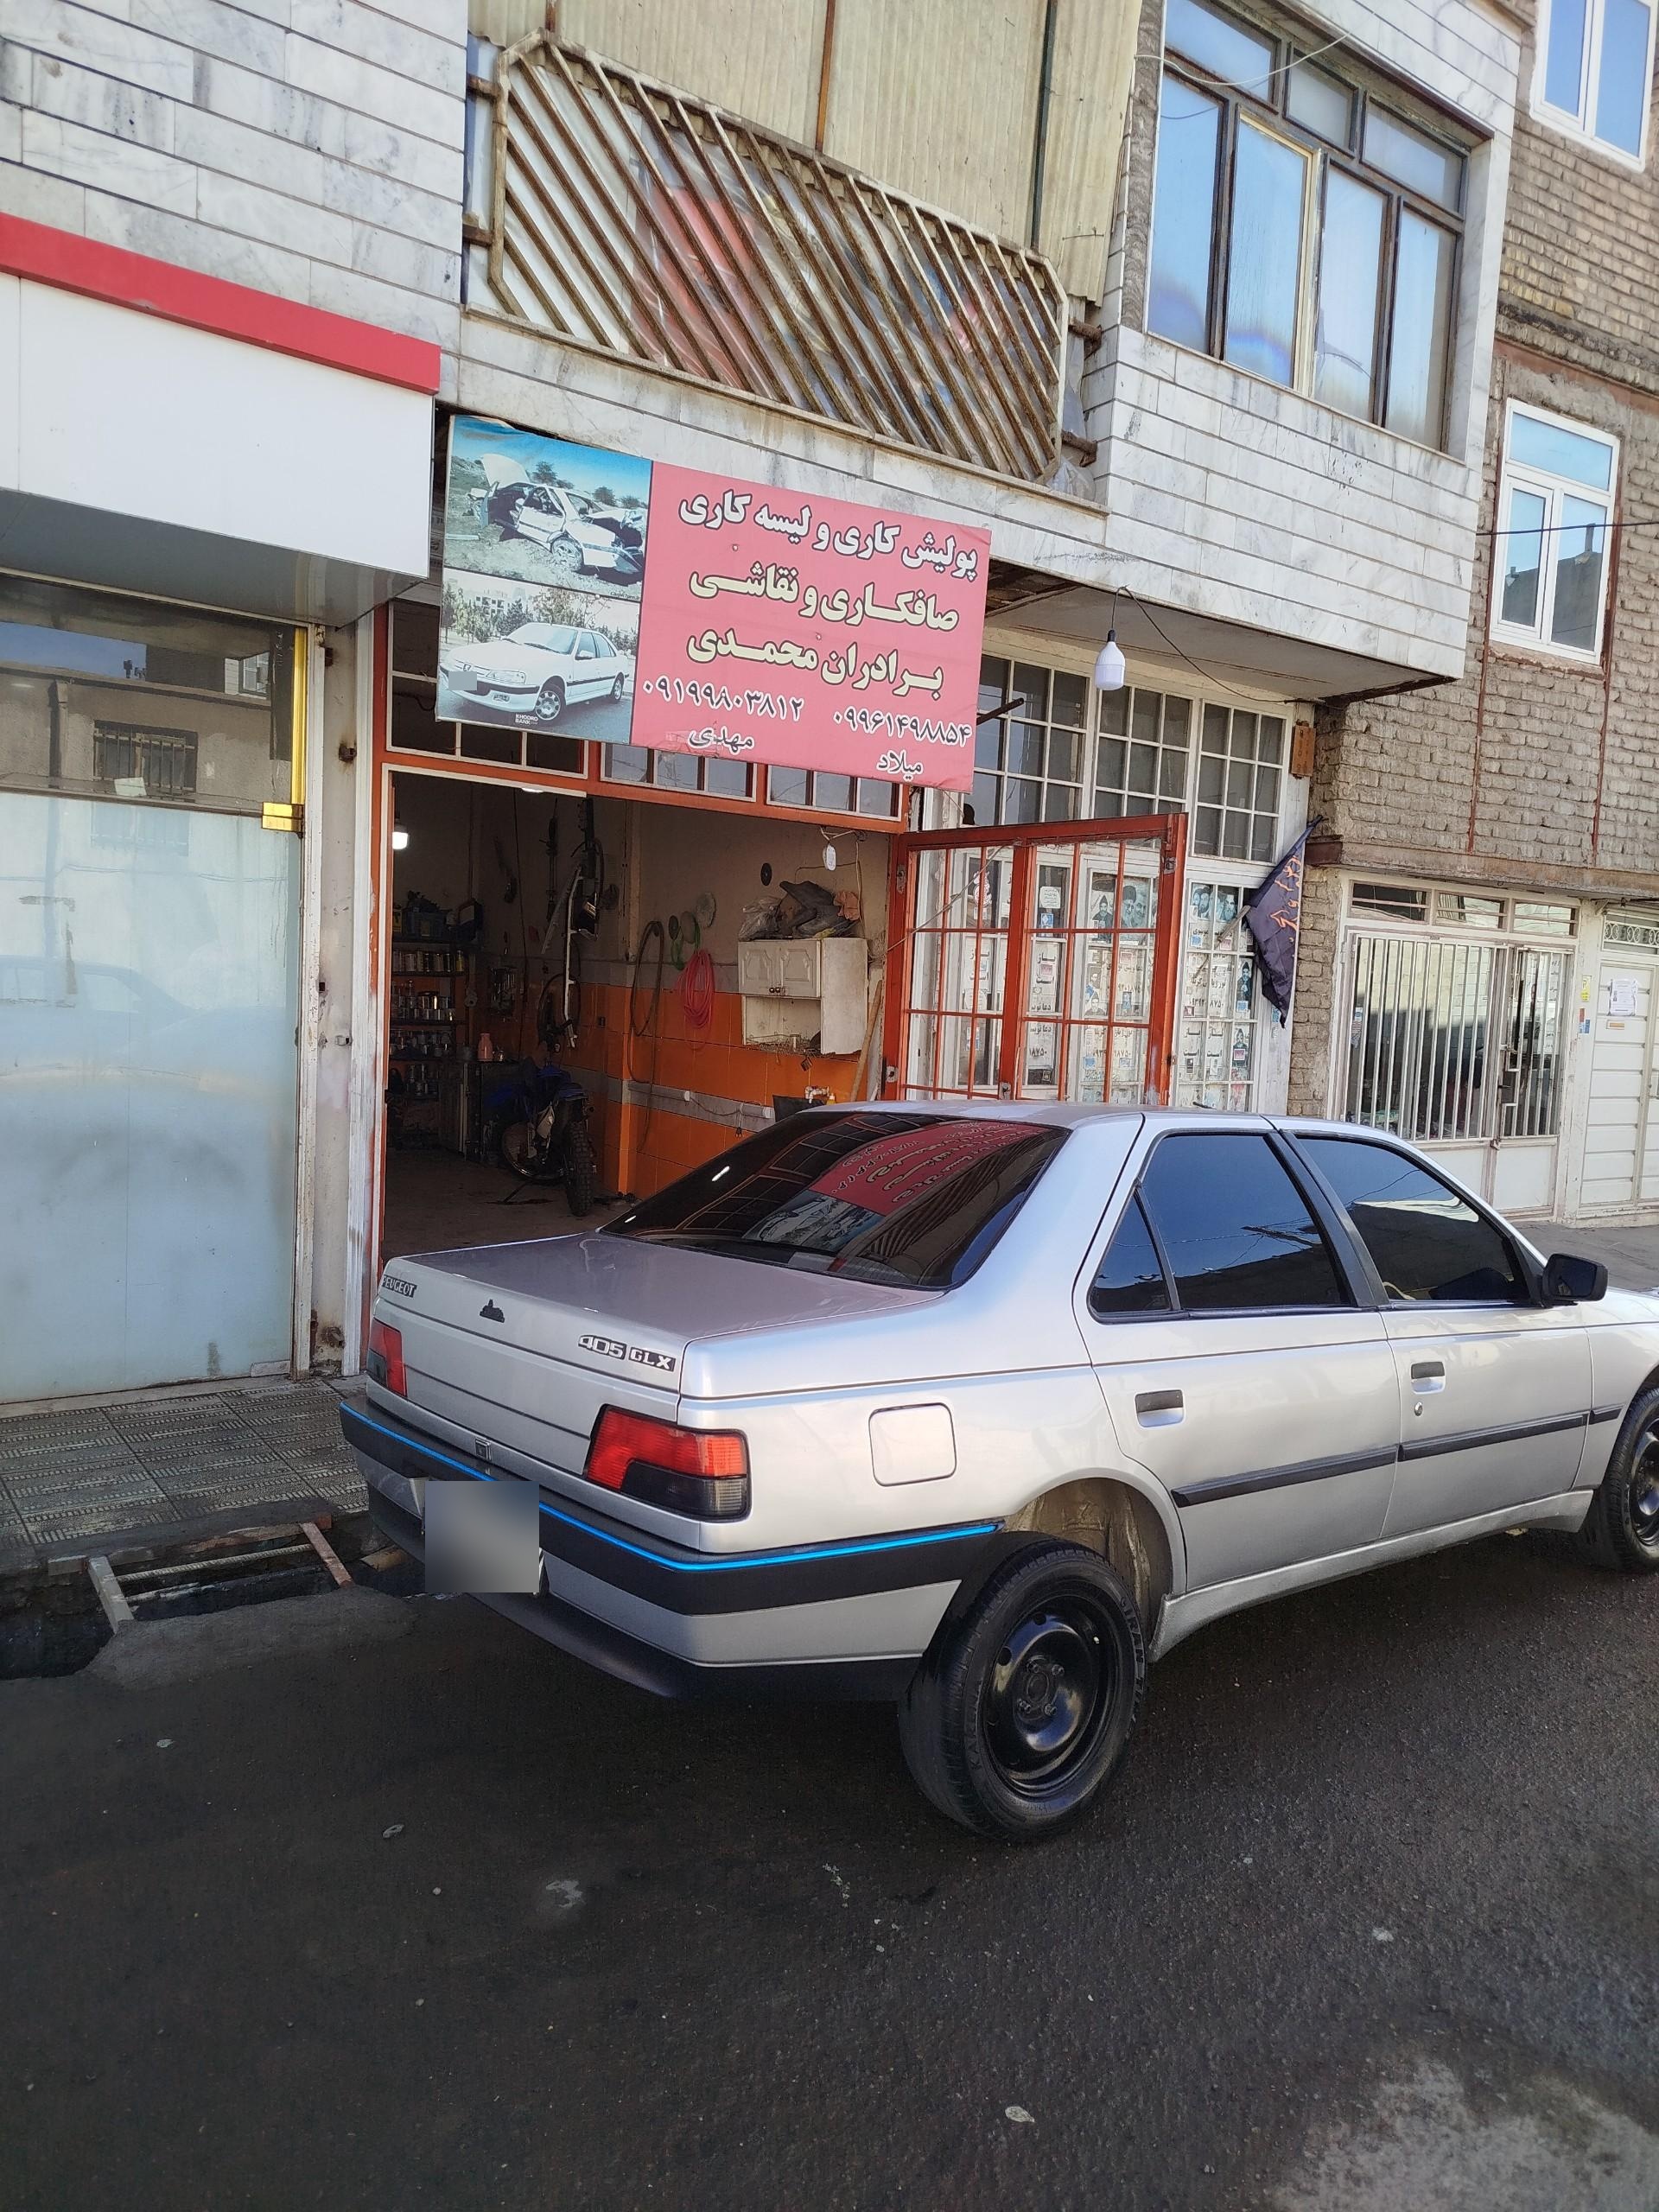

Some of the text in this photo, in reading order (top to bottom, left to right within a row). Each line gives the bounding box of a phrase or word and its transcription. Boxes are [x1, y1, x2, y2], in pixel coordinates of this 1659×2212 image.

[678, 489, 977, 582] پولیش کاری و لیسه کاری
[690, 561, 959, 632] صافکاری و نقاشی
[686, 628, 944, 701] برادران محمدی
[643, 675, 804, 721] ۰۹۱۹۹۸۰۳۸۱۲
[688, 726, 754, 754] مهدی
[833, 706, 973, 747] ۰۹۹۶۱۴۹۸۸۵۴
[876, 750, 923, 781] میلاد
[382, 1275, 416, 1296] PEUGEOT
[579, 1336, 672, 1370] 405 GLX
